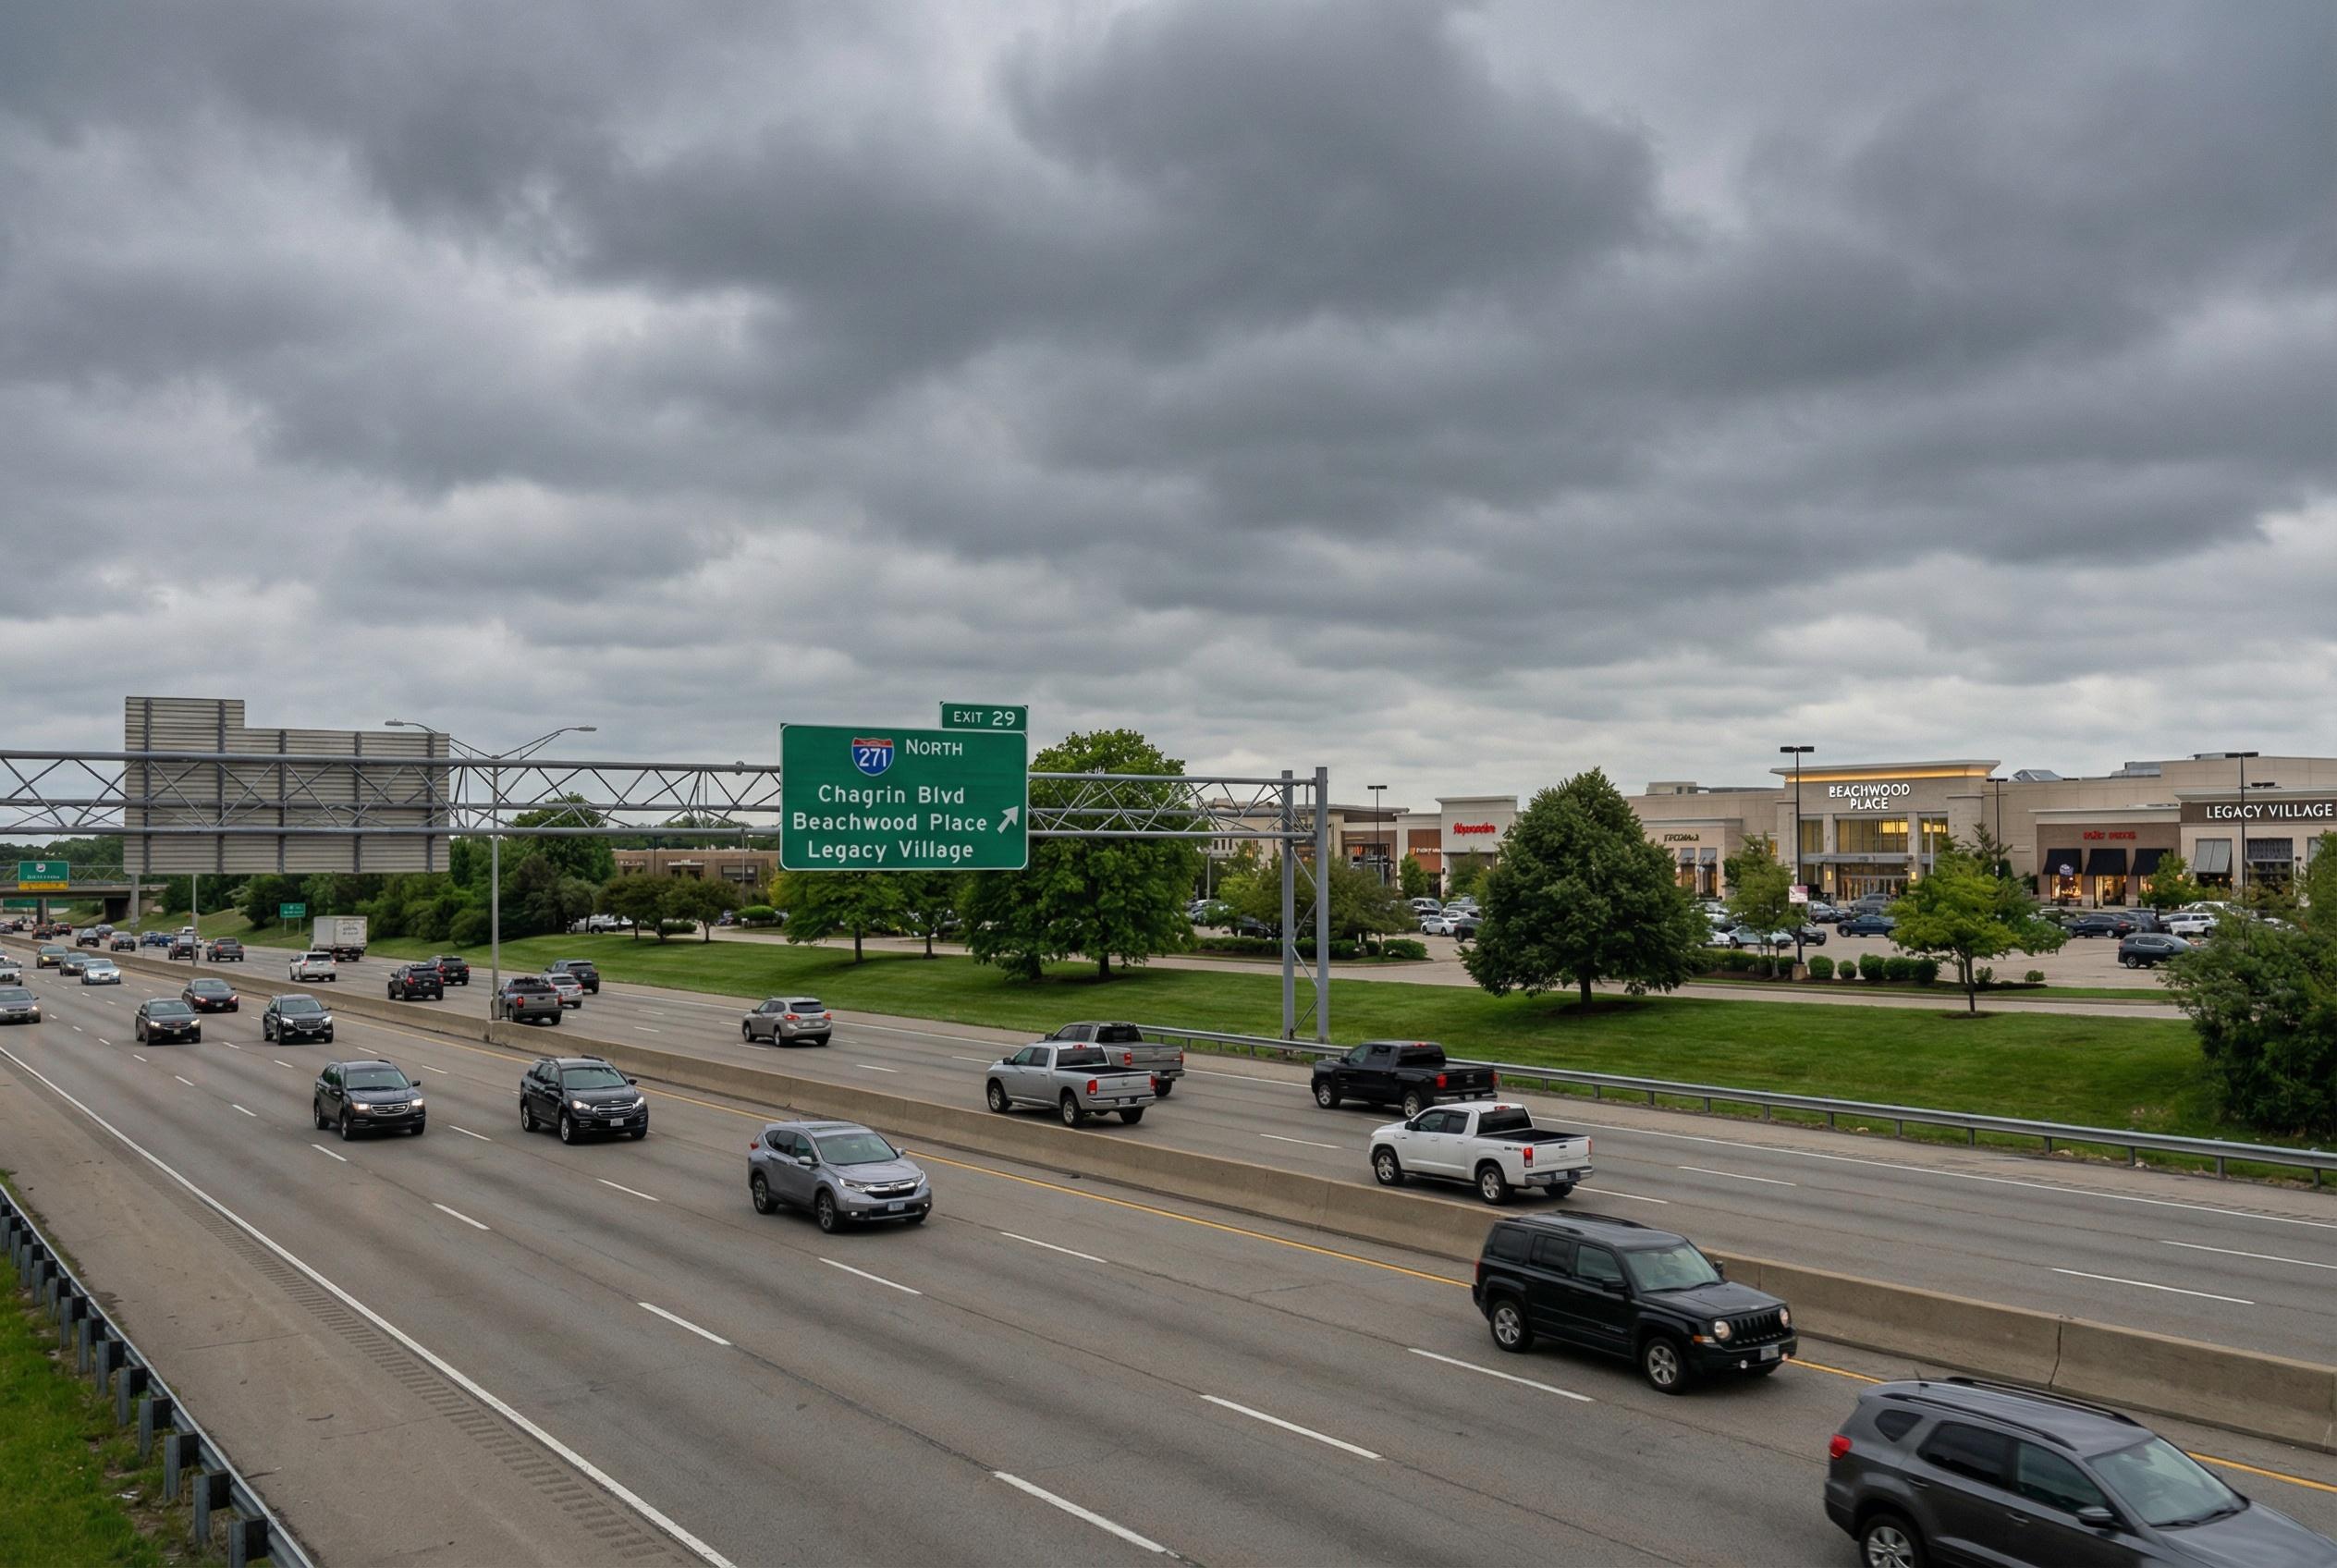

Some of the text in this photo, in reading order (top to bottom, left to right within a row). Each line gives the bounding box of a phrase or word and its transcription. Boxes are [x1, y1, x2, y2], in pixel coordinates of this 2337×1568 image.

[953, 710, 1016, 727] EXIT 29
[905, 739, 963, 756] NORTH
[859, 747, 887, 767] 271
[818, 784, 964, 809] Chagrin Blvd
[1829, 783, 1911, 798] BEACHWOOD
[1850, 797, 1890, 810] PLACE
[2206, 803, 2333, 819] LEGACY VILLAGE
[793, 812, 987, 831] Beachwood Place
[808, 839, 973, 864] Legacy Village
